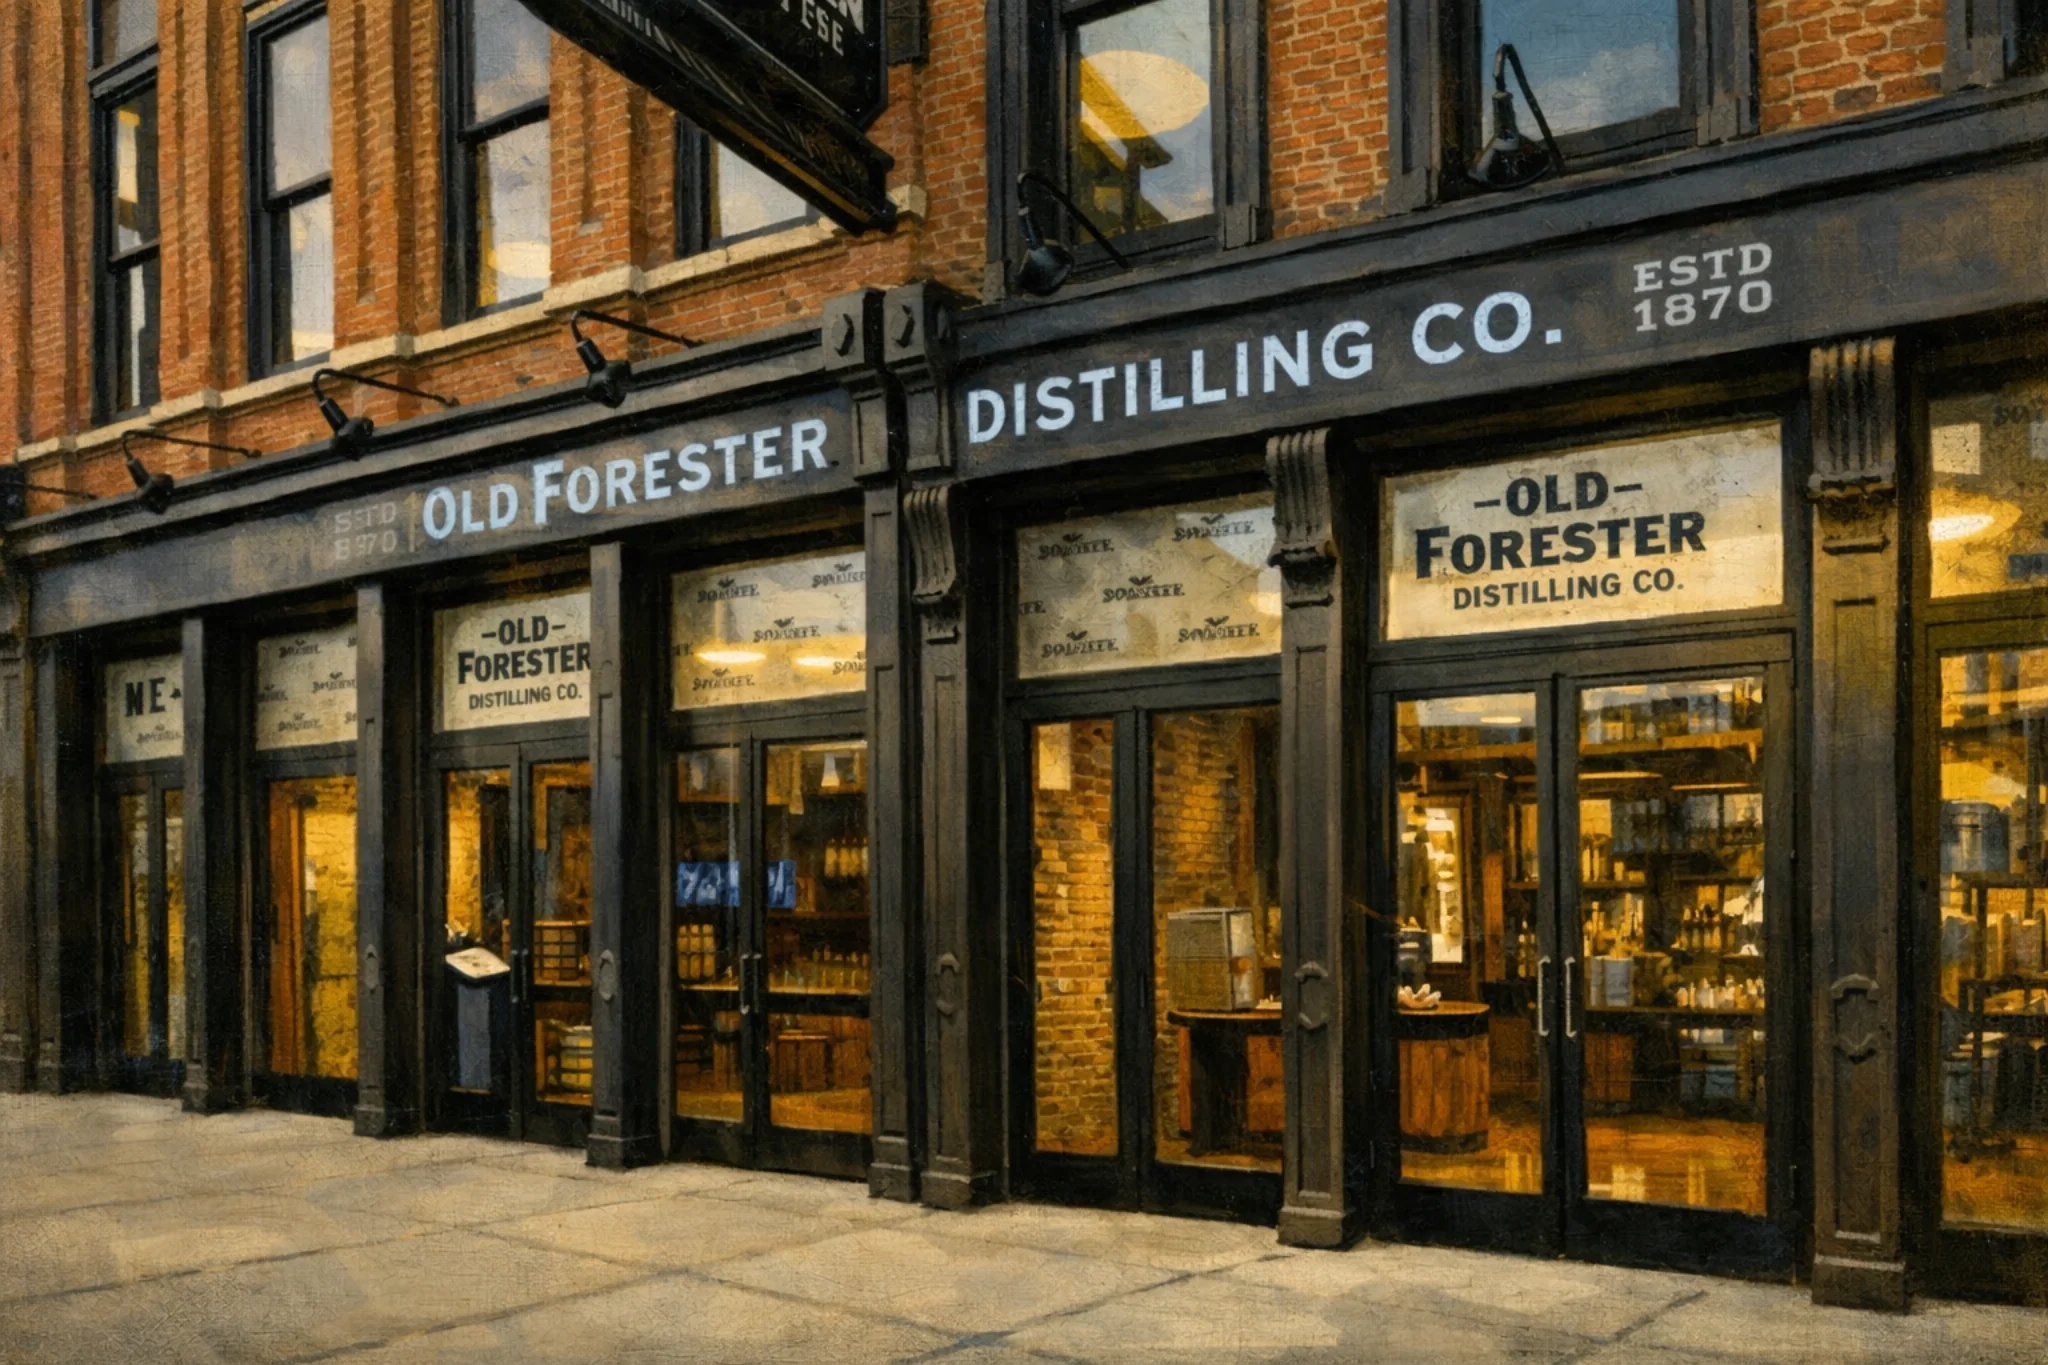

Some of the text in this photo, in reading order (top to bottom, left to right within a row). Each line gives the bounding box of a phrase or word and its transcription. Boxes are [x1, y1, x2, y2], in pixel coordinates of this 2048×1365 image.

[1633, 242, 1773, 293] ESTD
[1633, 280, 1773, 333] 1870
[967, 291, 1562, 445] DISTILLING CO.
[423, 418, 828, 541] OLD FORESTER
[1416, 512, 1707, 579] FORESTER
[1454, 567, 1685, 611] DISTILLING CO.
[457, 642, 591, 685] FORESTER
[469, 682, 583, 710] DISTILLING CO.
